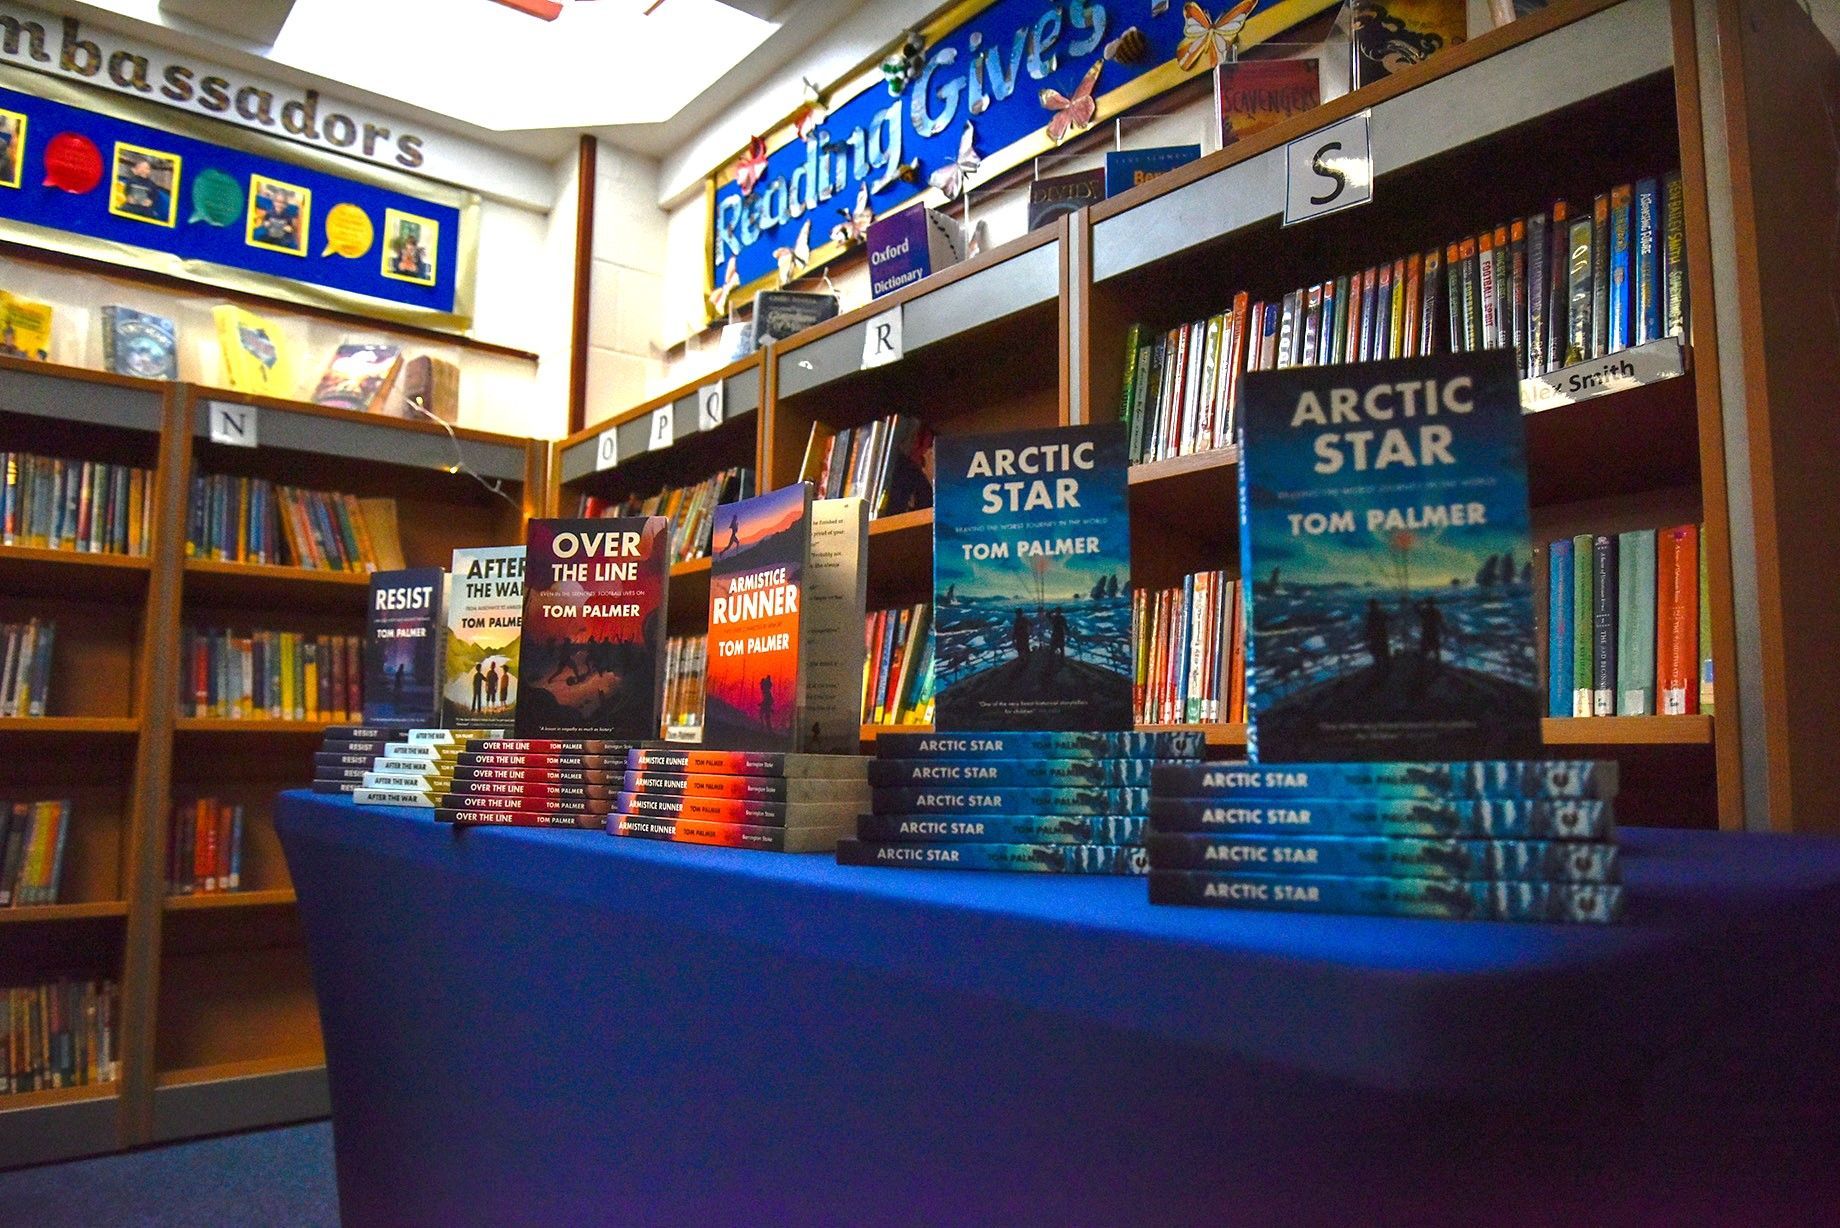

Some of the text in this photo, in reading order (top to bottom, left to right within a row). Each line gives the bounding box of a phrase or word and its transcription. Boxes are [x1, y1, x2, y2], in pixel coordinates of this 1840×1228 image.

[0, 15, 425, 169] mbassadors
[716, 0, 1106, 266] Reading Gives
[1310, 141, 1345, 206] S
[871, 238, 910, 267] Oxford
[873, 267, 924, 295] Dictionary
[1482, 260, 1494, 327] FOOTBALL SPIRIT
[875, 322, 895, 356] R
[1569, 360, 1635, 393] Smith
[707, 391, 720, 423] Q
[1291, 376, 1474, 427] ARCTIC
[220, 411, 247, 436] N
[658, 414, 668, 440] P
[602, 437, 614, 461] O
[1313, 425, 1456, 474] STAR
[966, 441, 1095, 478] ARCTIC
[981, 477, 1081, 514] STAR
[1287, 502, 1487, 536] TOM PALMER
[552, 531, 641, 559] OVER
[962, 536, 1100, 561] TOM PALMER
[551, 562, 638, 582] THE LINE
[728, 567, 786, 594] ARMISTICE
[466, 581, 524, 599] THE WA
[375, 586, 434, 611] RESIST
[713, 584, 798, 625] RUNNER
[542, 604, 641, 618] TOM PALMER
[462, 616, 522, 629] TOM PALME
[376, 627, 427, 639] TOM PALMER
[718, 633, 790, 657] TOM PALMER
[349, 743, 373, 751] RESIST
[394, 747, 408, 755] AFTER
[483, 742, 530, 750] OVER THE LINE
[919, 740, 1004, 751] ARCTIC STAR
[342, 756, 367, 764] RESIST
[385, 762, 401, 770] AFTER
[412, 763, 427, 771] WAR
[476, 755, 525, 764] OVER THE LINE
[638, 756, 689, 766] ARMISTICE RUNNER
[344, 769, 366, 777] RESIS
[473, 770, 525, 779] OVER THE LINE
[912, 767, 998, 779] ARCTIC STAR
[1202, 772, 1309, 788] ARCTIC STAR
[375, 777, 391, 785] AFTER
[403, 778, 418, 786] WAR
[470, 783, 524, 793] OVER THE LINE
[635, 778, 688, 789] ARMISTICE RUNNER
[464, 798, 522, 808] OVER THE LINE
[628, 800, 683, 812] ARMISTICE RUNNER
[916, 795, 1002, 807] ARCTIC STAR
[456, 812, 513, 823] OVER THE LINE
[702, 806, 720, 814] PALMER
[1201, 808, 1311, 824] ARCTIC STAR
[537, 816, 575, 825] TOM PALMER
[618, 822, 676, 834] ARMISTICE RUNNER
[900, 822, 985, 835] ARCTIC STAR
[696, 829, 716, 837] PALMER
[877, 848, 960, 862] ARCTIC STAR
[1204, 845, 1319, 864] ARCTIC STAR
[1204, 883, 1320, 902] ARCTIC STAR
